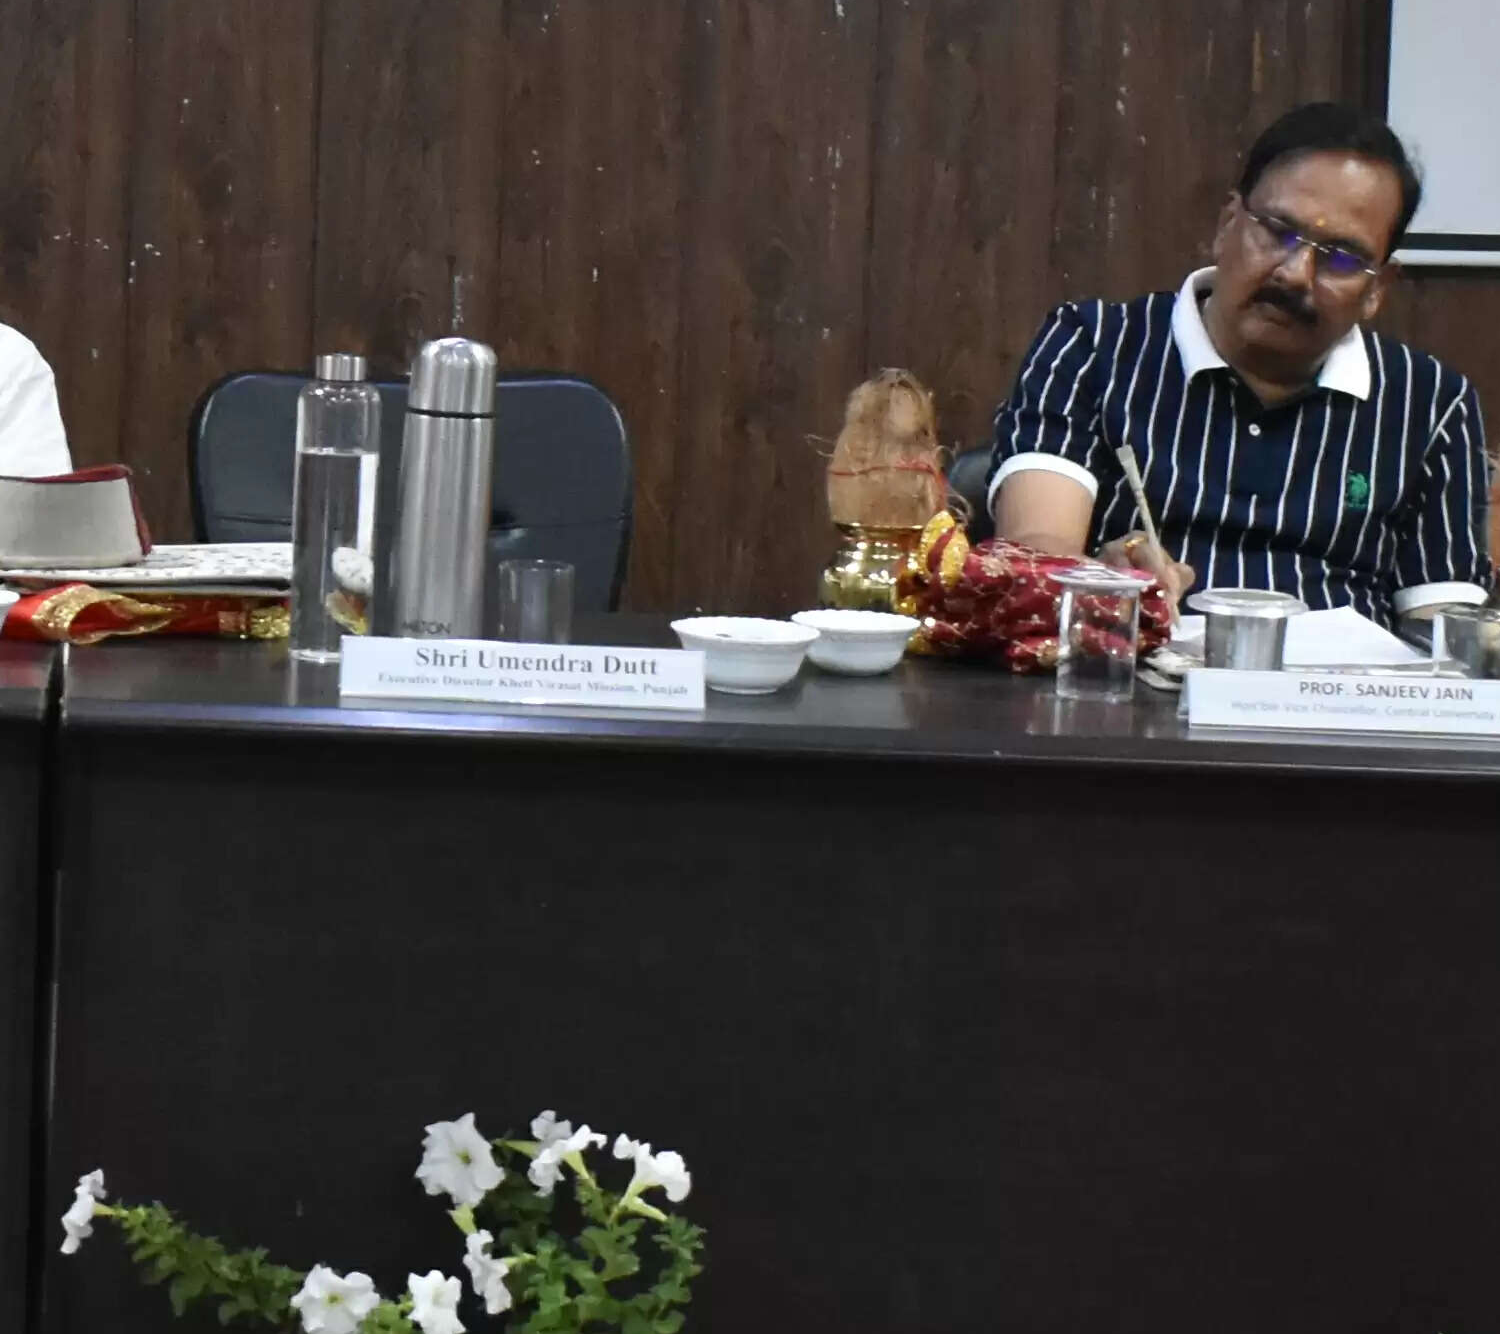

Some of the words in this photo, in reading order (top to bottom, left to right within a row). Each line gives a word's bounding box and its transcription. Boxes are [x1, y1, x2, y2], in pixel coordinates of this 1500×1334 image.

[415, 647, 467, 668] Shri
[478, 650, 593, 673] Umendra
[604, 655, 657, 675] Dutt
[1299, 681, 1350, 696] PROF.
[1355, 683, 1430, 700] SANJEEV
[1436, 686, 1473, 701] JAIN
